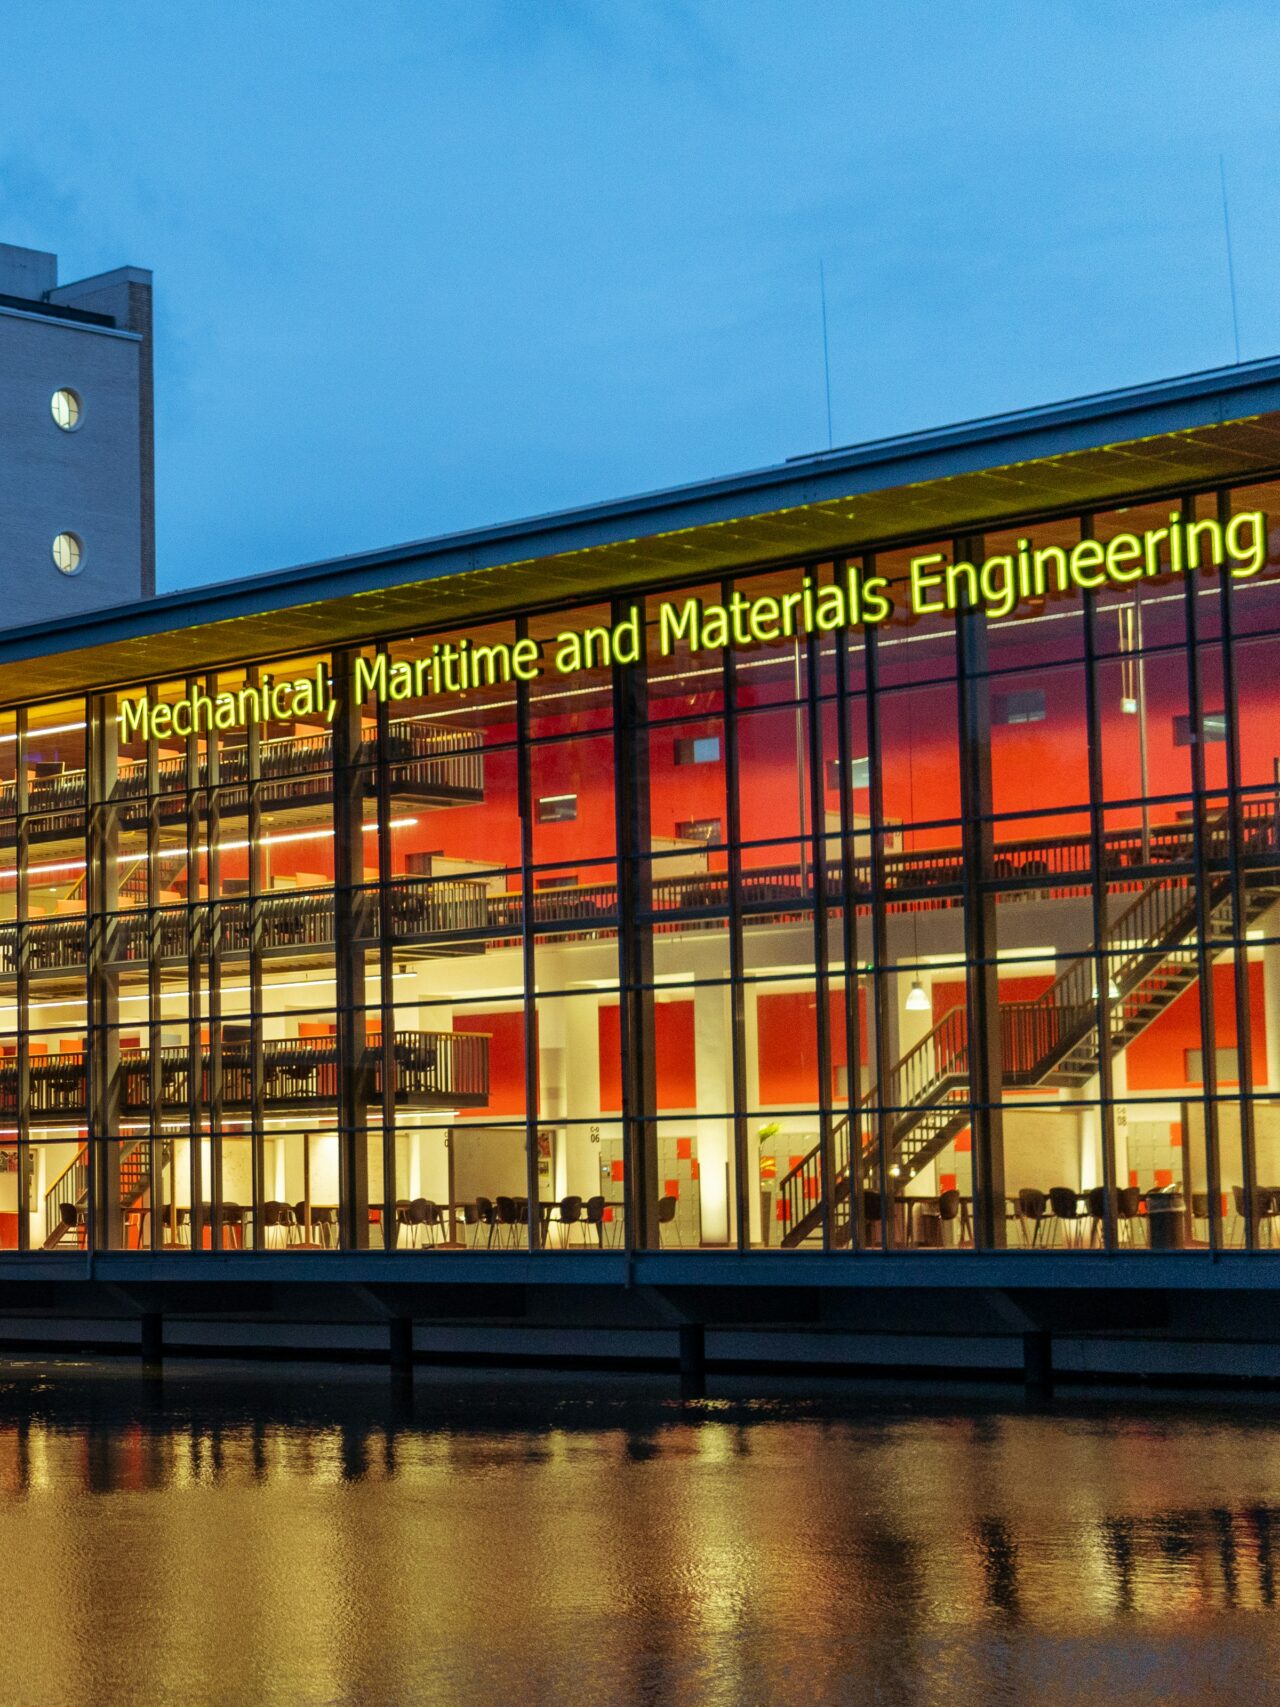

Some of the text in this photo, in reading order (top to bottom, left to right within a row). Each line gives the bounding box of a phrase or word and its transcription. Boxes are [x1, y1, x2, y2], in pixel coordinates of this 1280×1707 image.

[118, 510, 1265, 745] Mechanical, Maritime and Materials Engineering
